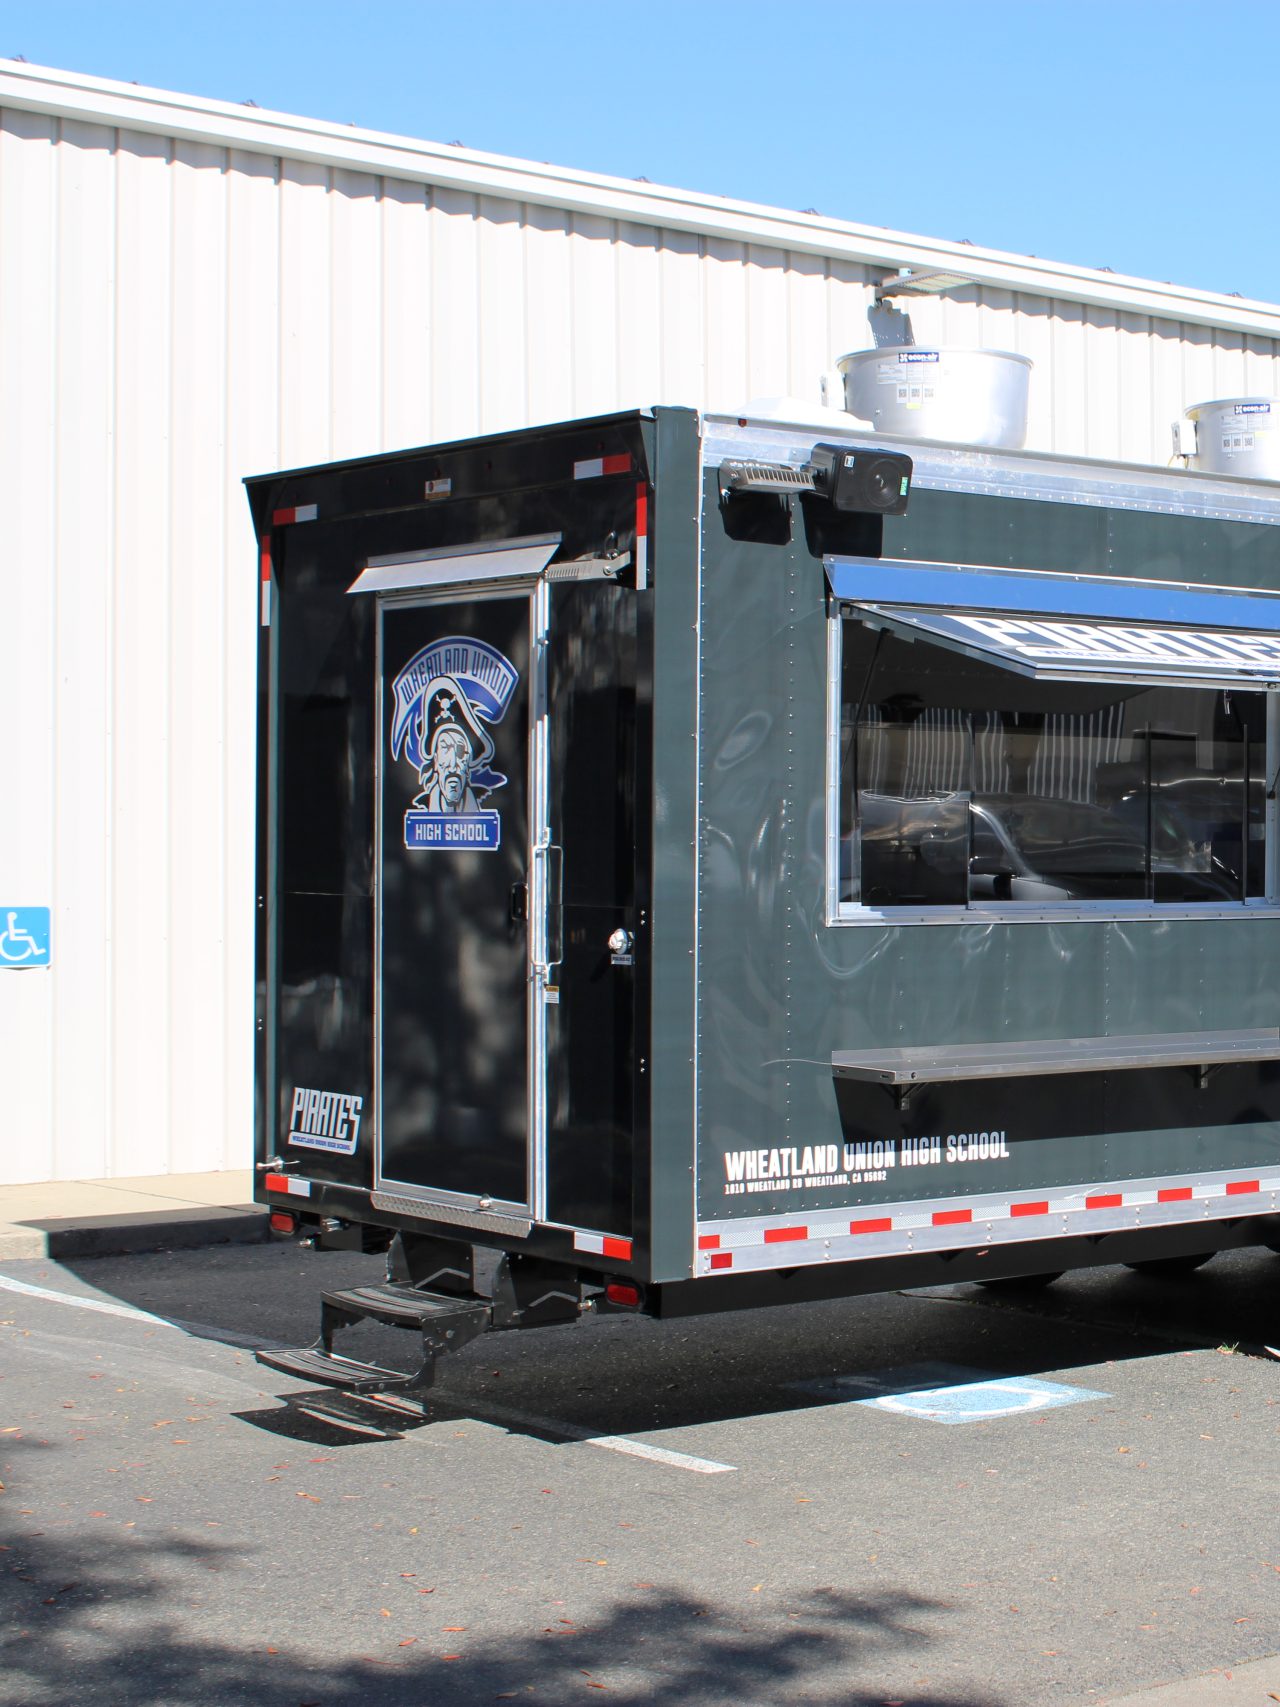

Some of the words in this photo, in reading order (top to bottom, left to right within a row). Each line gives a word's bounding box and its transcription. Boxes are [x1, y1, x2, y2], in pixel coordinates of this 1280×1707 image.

[400, 647, 469, 705] WHEATLAND
[471, 650, 510, 701] UNION
[415, 823, 441, 841] HIGH
[444, 823, 490, 841] SCHOOL
[290, 1087, 363, 1140] PIRATES
[724, 1144, 838, 1182] WHEATLAND
[843, 1139, 896, 1172] UNION
[901, 1135, 941, 1167] HIGH
[946, 1131, 1010, 1163] SCHOOL
[746, 1178, 790, 1193] WHEATLAND
[852, 1172, 862, 1184] CA
